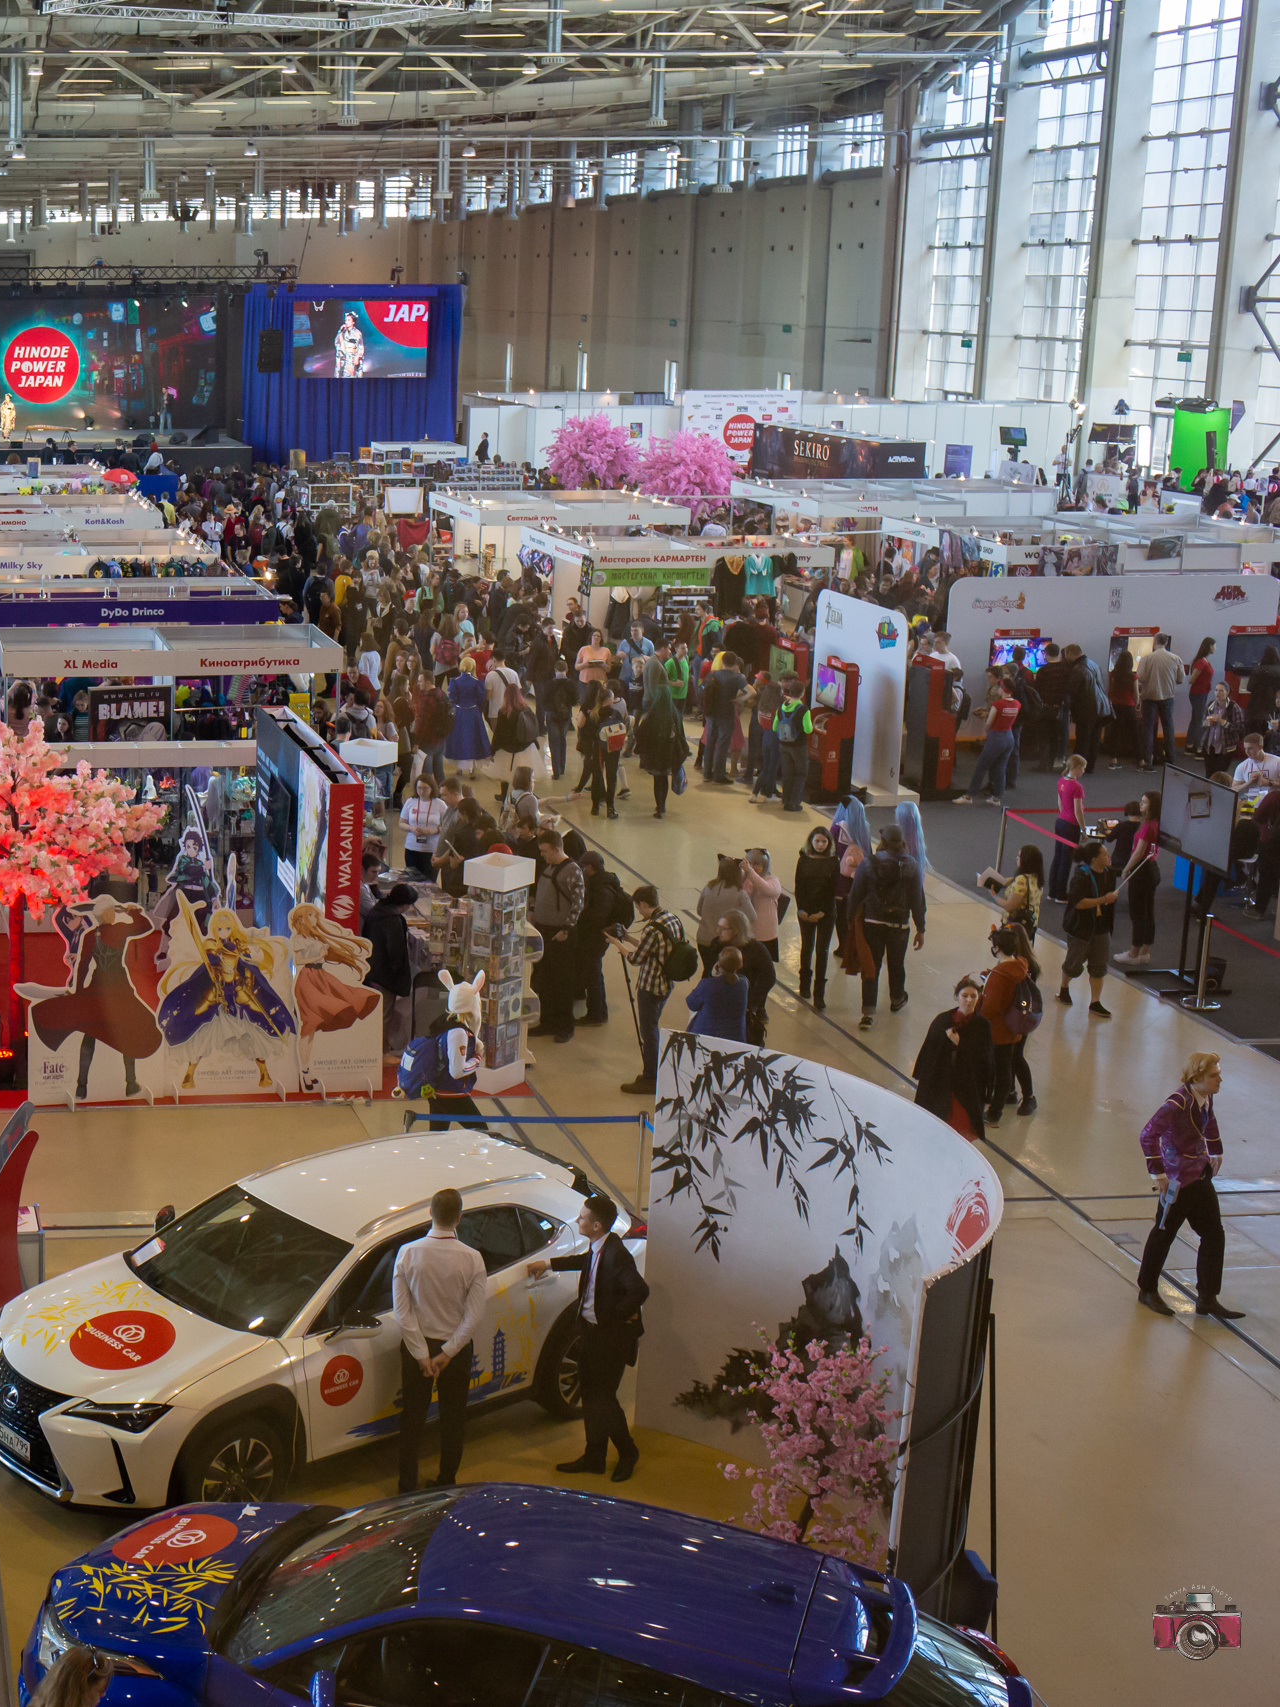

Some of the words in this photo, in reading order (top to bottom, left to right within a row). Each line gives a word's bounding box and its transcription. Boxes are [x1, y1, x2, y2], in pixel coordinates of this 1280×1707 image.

[13, 346, 70, 358] HINODE
[10, 361, 66, 373] POWER
[18, 375, 64, 387] JAPAN
[728, 422, 754, 430] HINODE
[794, 440, 830, 461] SEKIRO
[507, 514, 538, 522] Светлый
[599, 555, 650, 564] Мастерская
[0, 562, 22, 572] Milky
[26, 562, 43, 571] Sky
[101, 608, 129, 619] DyDo
[132, 607, 165, 617] Drinco
[64, 660, 78, 668] XL
[81, 659, 118, 668] Media
[199, 656, 300, 668] Киноатрибутика
[98, 701, 165, 720] BLAME!
[337, 803, 354, 889] WAKANIM
[43, 1061, 65, 1074] Fate
[84, 1326, 124, 1350] BUSINESS
[122, 1348, 142, 1362] CAR
[15, 1436, 28, 1454] 799
[150, 1518, 191, 1544] BUSINESS
[132, 1545, 154, 1559] CAR
